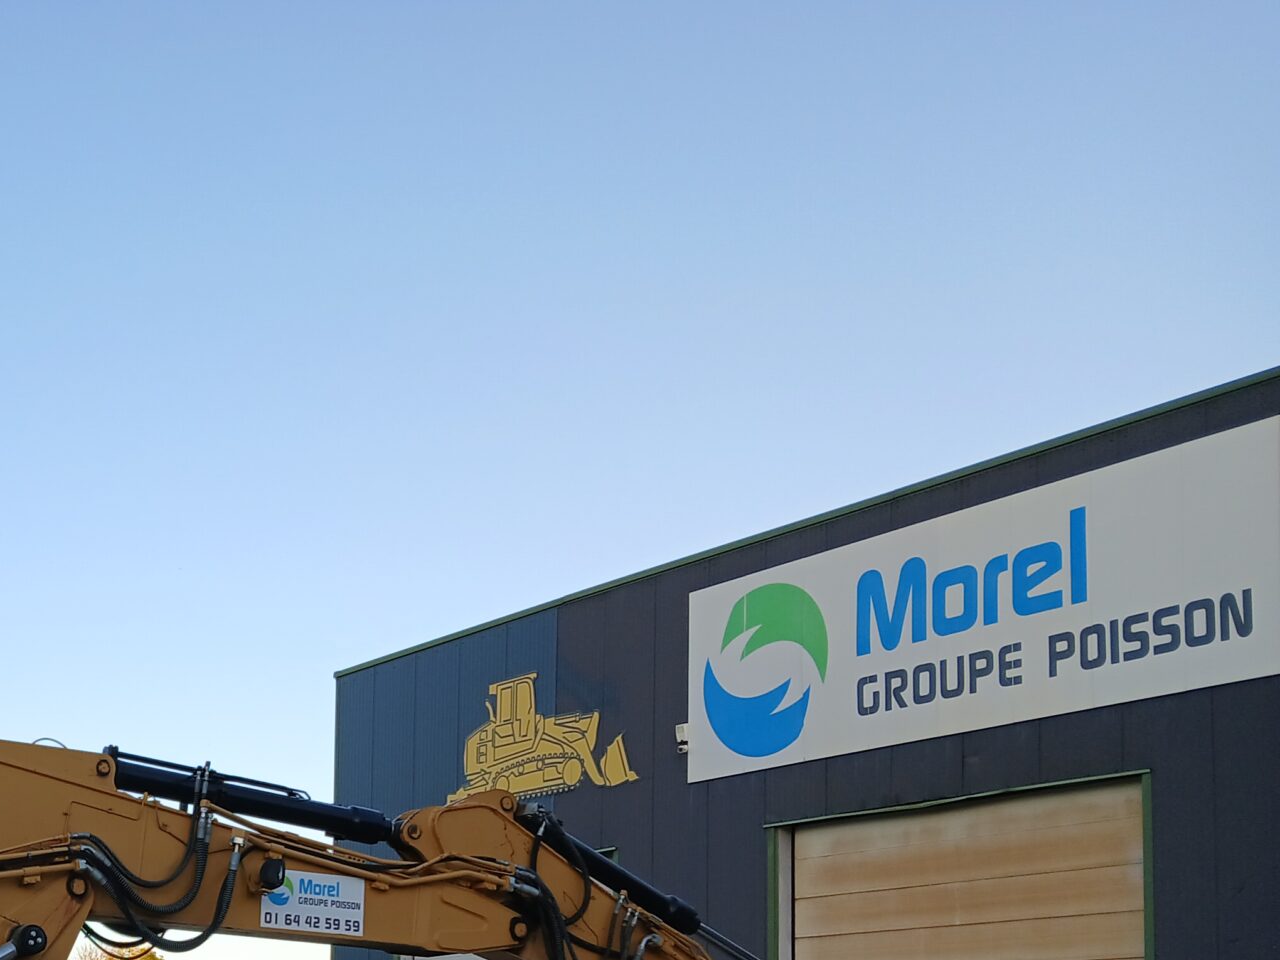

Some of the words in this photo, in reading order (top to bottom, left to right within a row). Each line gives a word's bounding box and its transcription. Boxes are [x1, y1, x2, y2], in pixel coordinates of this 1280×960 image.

[856, 505, 1088, 657] Morel
[856, 642, 1023, 717] GROUPE
[1048, 588, 1254, 678] POISSON
[299, 878, 340, 898] Morel
[298, 897, 328, 907] GROUPE
[330, 900, 361, 910] POISSON
[264, 911, 278, 925] 01
[284, 913, 300, 927] 64
[304, 915, 320, 929] 42
[324, 917, 340, 931] 59
[344, 919, 360, 932] 59
